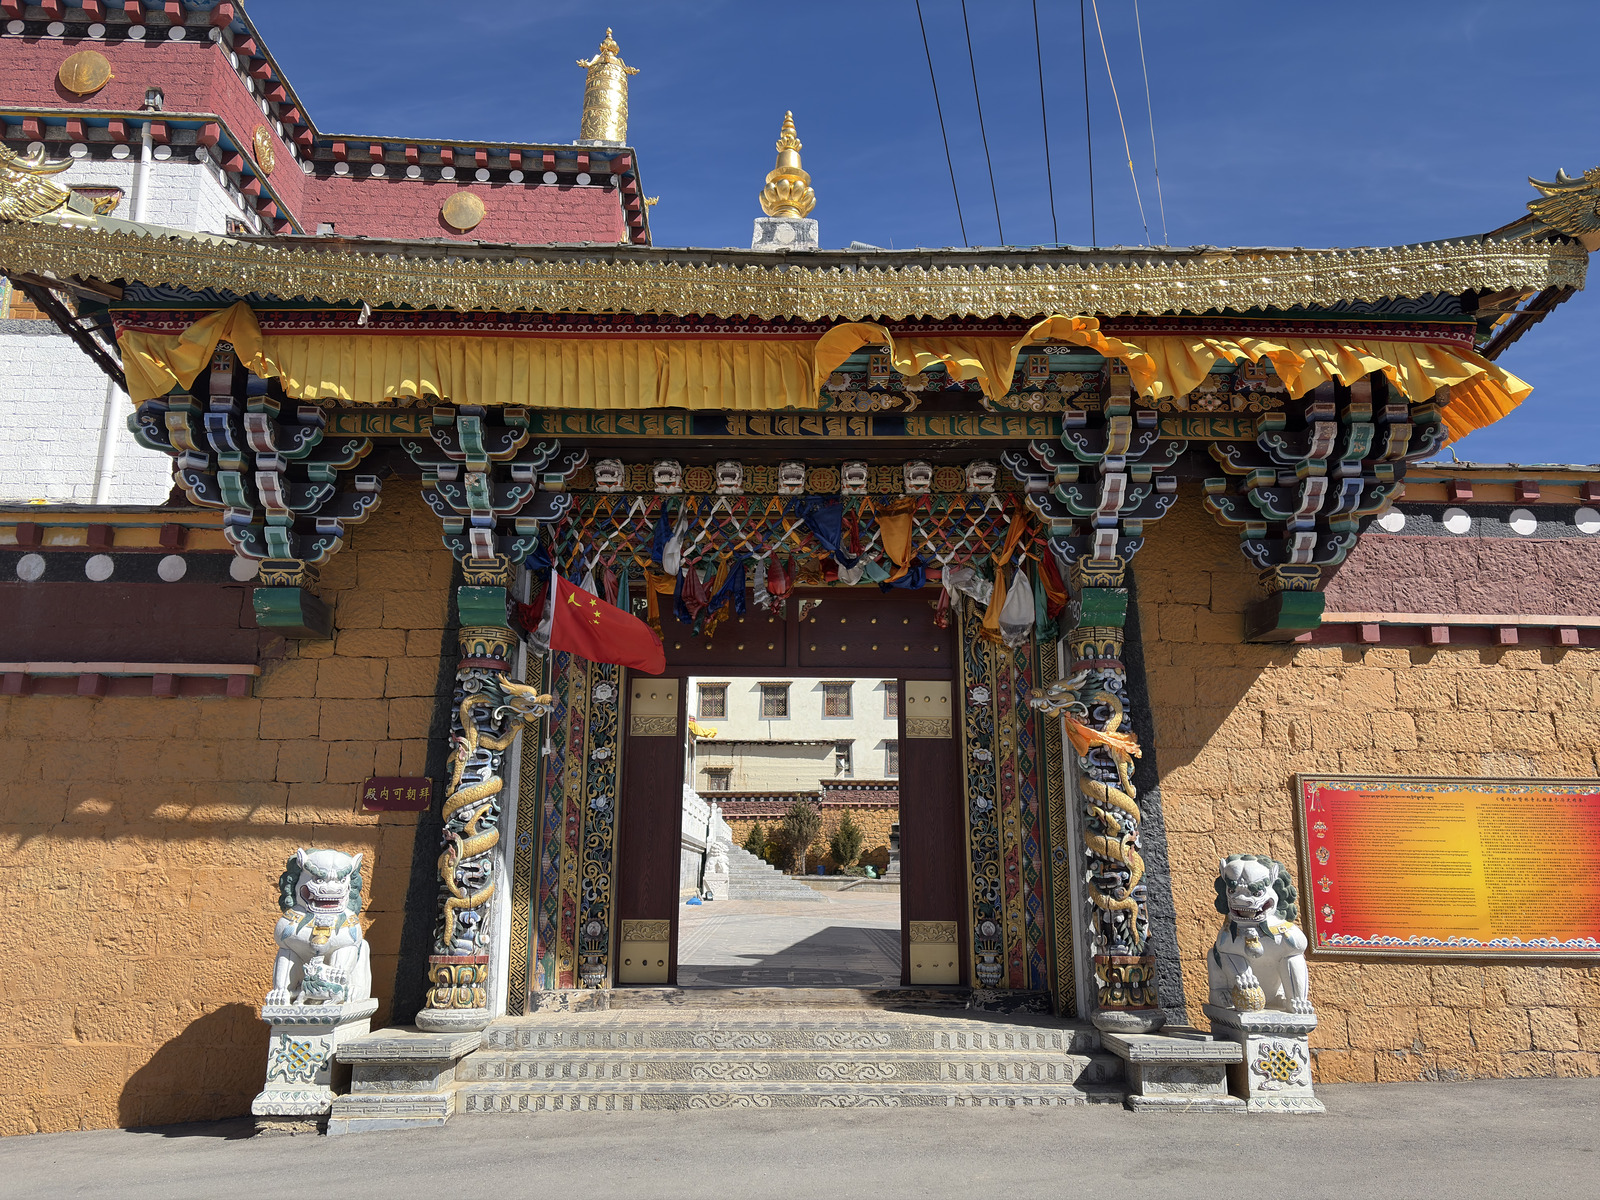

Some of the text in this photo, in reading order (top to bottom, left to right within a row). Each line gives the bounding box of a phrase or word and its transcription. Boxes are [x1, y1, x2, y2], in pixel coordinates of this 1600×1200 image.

[364, 786, 430, 802] 殿内可朝拜
